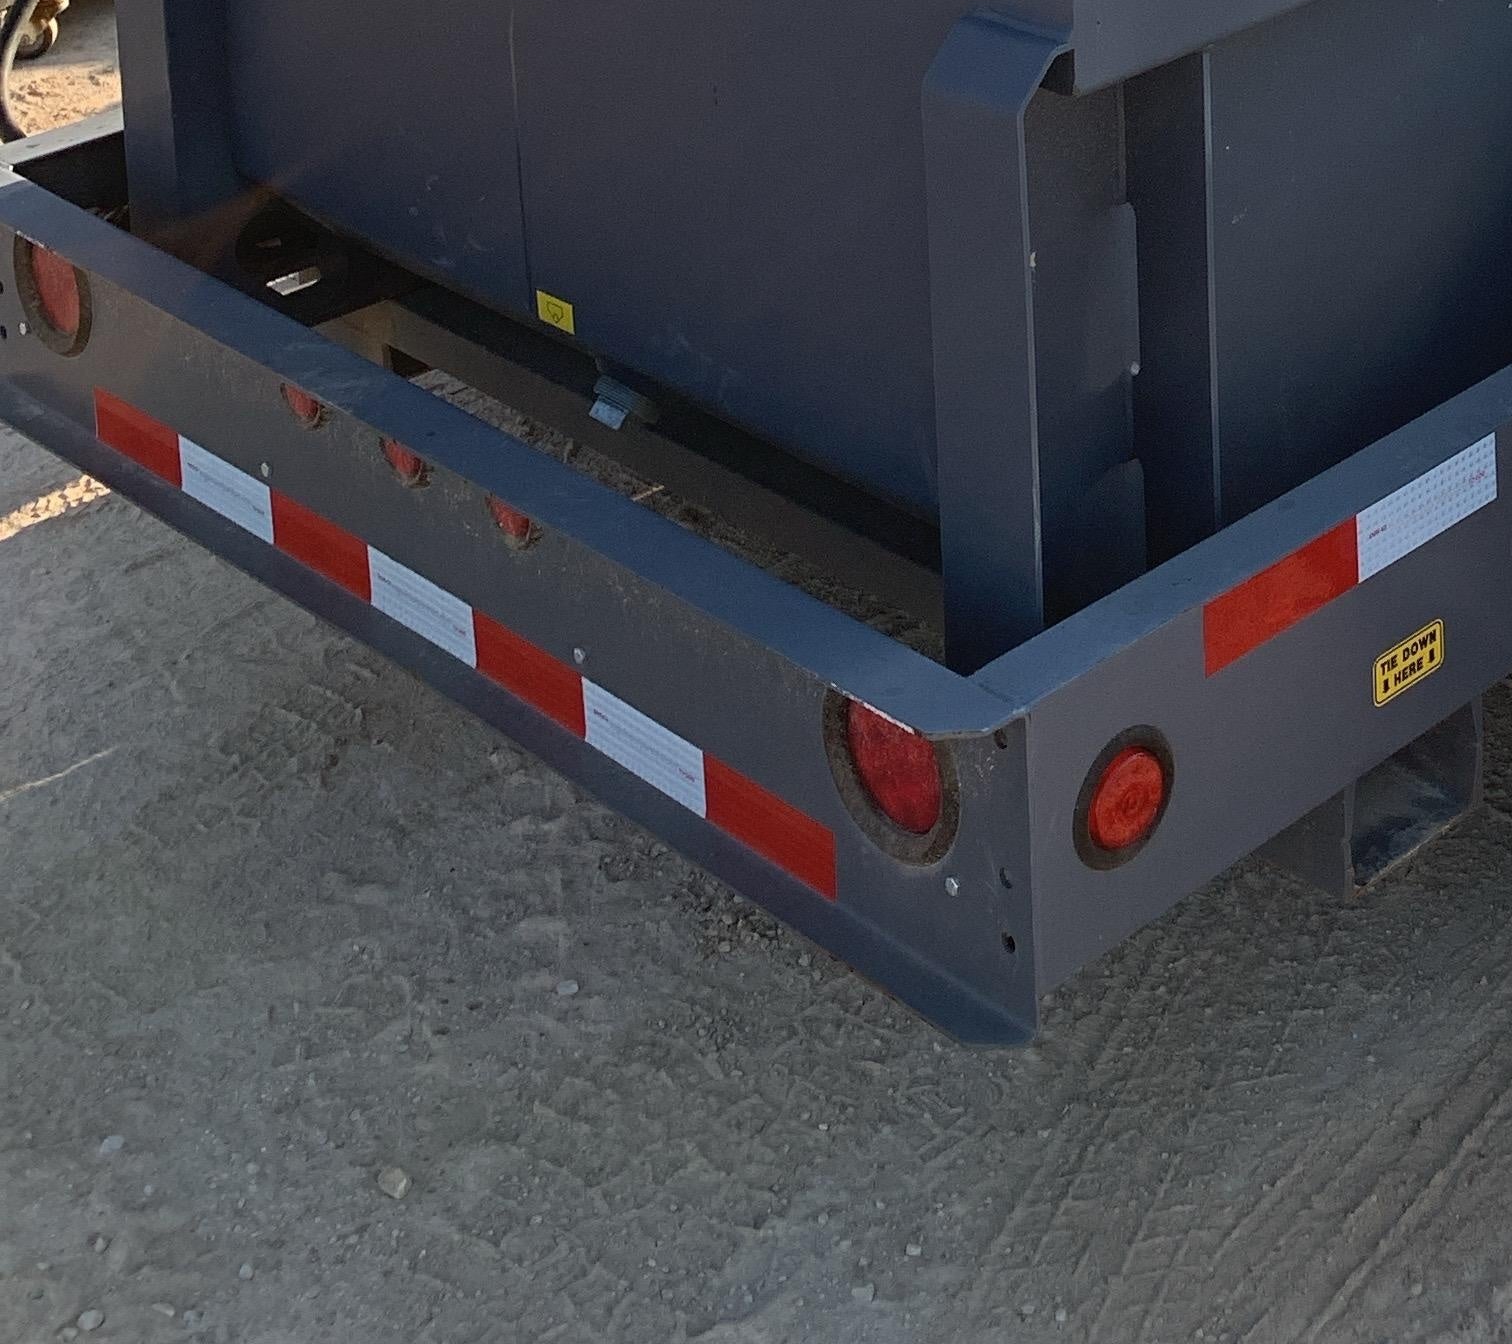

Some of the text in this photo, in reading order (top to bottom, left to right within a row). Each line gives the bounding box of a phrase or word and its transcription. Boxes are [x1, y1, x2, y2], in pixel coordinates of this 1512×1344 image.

[1380, 629, 1437, 676] TIE DOWN
[1394, 656, 1424, 687] HERE
